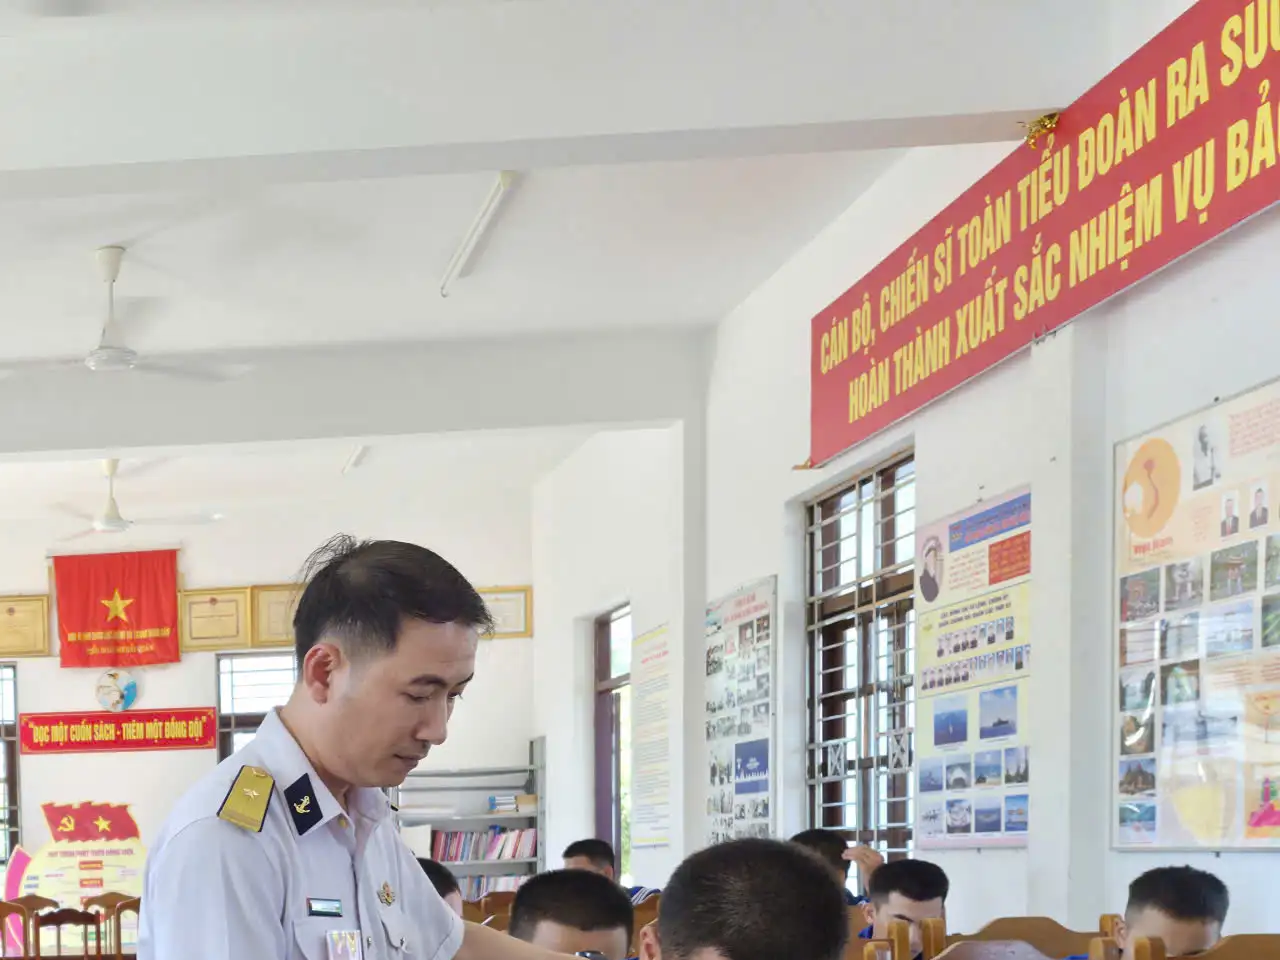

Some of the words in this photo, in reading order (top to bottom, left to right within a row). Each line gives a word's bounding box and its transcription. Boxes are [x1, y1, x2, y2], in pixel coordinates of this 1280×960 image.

[821, 318, 849, 375] CÁN
[852, 293, 876, 355] BỘ,
[879, 247, 929, 333] CHIẾN
[933, 225, 954, 294] SĨ
[958, 190, 1012, 276] TOÀN
[1018, 135, 1071, 232] TIỂU
[1078, 79, 1157, 191] ĐOÀN
[1167, 41, 1210, 128] RA
[848, 357, 890, 424] HOÀN
[894, 317, 951, 396] THÀNH
[955, 266, 1008, 360] XUẤT
[1013, 233, 1062, 321] SẮC
[1069, 174, 1163, 271] NHIỆM
[1173, 138, 1215, 225] VỤ
[1226, 79, 1280, 193] BẢ
[94, 720, 116, 742] SÁCH
[122, 719, 144, 741] THÊM
